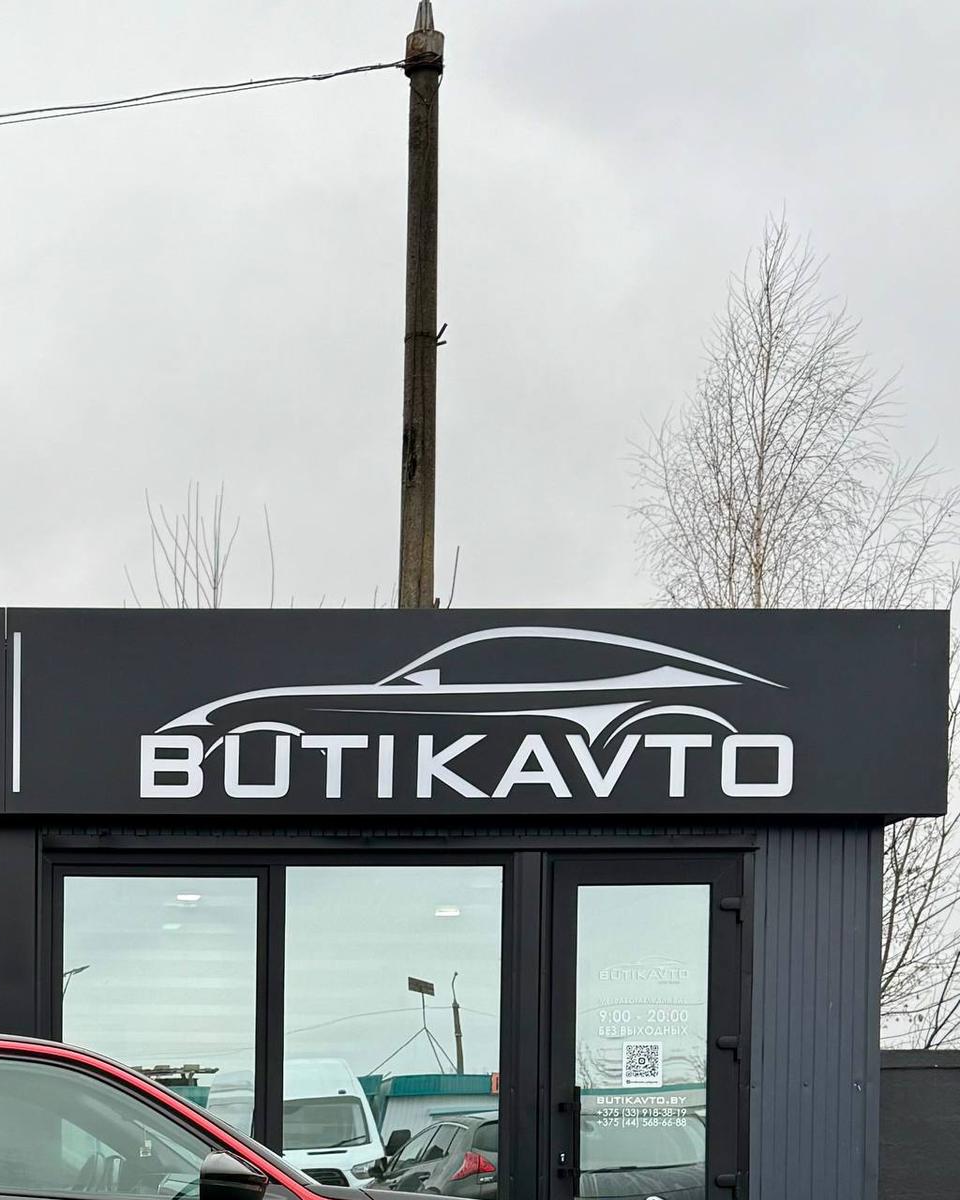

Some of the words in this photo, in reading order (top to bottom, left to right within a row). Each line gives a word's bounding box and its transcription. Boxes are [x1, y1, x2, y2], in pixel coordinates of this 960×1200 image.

[140, 734, 794, 799] BUTIKAVTO
[599, 1010, 631, 1023] 9:00
[647, 1010, 688, 1023] 20:00
[598, 1025, 618, 1036] БЕЗ
[620, 1025, 688, 1036] ВЫХОДНЫХ
[596, 1096, 687, 1105] BUTIKAVTO.BY
[597, 1108, 620, 1117] +375
[622, 1107, 640, 1119] (33)
[642, 1108, 688, 1118] 918-38-19
[597, 1118, 619, 1127] +375
[622, 1117, 640, 1129] (44)
[642, 1118, 688, 1127] 568-66-88
